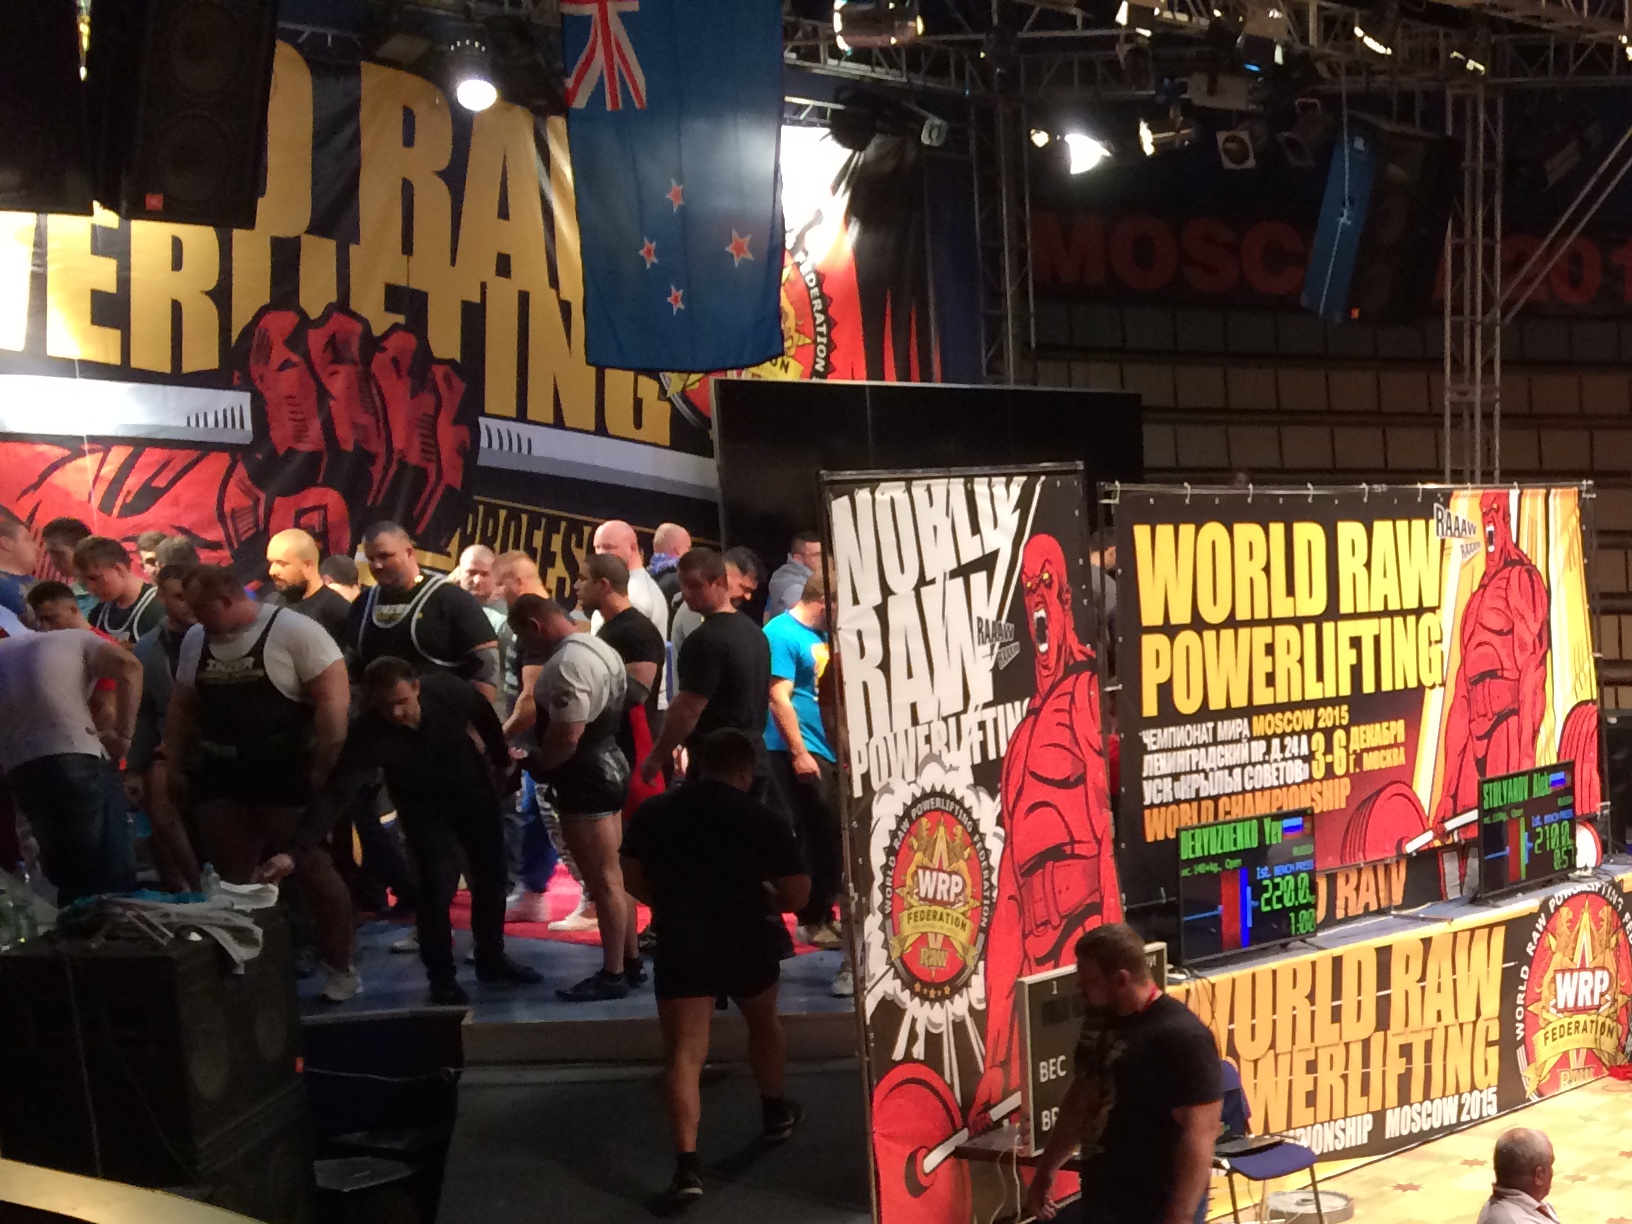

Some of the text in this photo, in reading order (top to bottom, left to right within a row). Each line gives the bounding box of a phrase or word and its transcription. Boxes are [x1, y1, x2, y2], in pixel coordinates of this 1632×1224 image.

[1132, 518, 1443, 627] WORLD RAW
[838, 571, 997, 742] RAW
[1140, 611, 1445, 718] POWERLIFTING
[1140, 717, 1251, 752] ЧЕМПИОНАТ МИРА
[1251, 704, 1350, 738] MOSCOW 2015
[1350, 719, 1406, 755] ДЕКАБРЯ
[1141, 737, 1250, 778] ЛЕНИНГРАДСКИЙ
[1311, 728, 1348, 781] 3-6
[1362, 746, 1406, 772] МОСКВА
[1142, 778, 1174, 807] УСК
[1143, 777, 1352, 843] WORLD CHAMPIONSHIP
[1180, 818, 1259, 861] DERYUZHENKO
[884, 797, 992, 929] WORLD RAW POWERLIFTING FEDERATION
[916, 867, 965, 903] WRP
[1335, 857, 1408, 920] RAW
[906, 907, 968, 933] FEDERATION
[1051, 980, 1059, 996] 1
[1389, 925, 1507, 1037] RAW
[1515, 964, 1530, 1041] WORLD
[1525, 911, 1548, 957] RAW
[1554, 969, 1611, 1011] WRP
[1542, 1018, 1616, 1048] FEDERATION
[1038, 1054, 1068, 1084] ВЕС
[1243, 1017, 1500, 1137] WERLIFTING
[1384, 1095, 1460, 1140] MOSCOW
[1460, 1085, 1499, 1123] 2015
